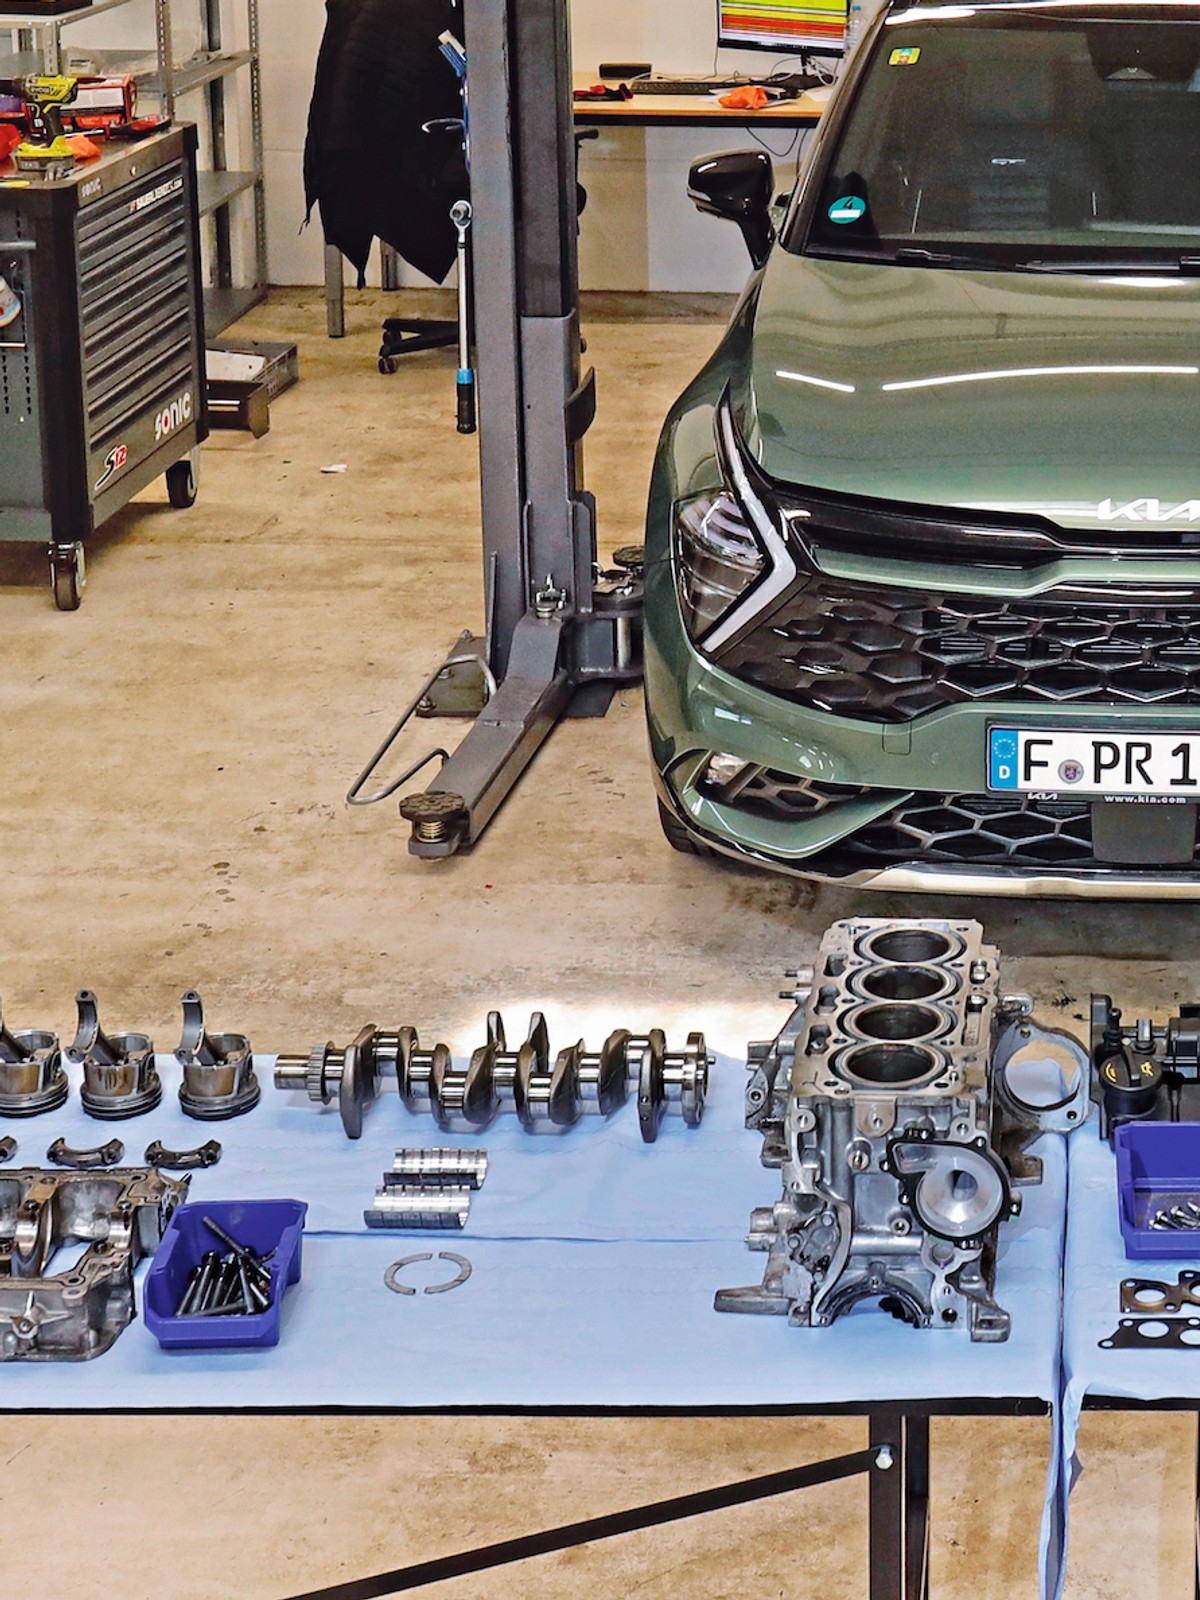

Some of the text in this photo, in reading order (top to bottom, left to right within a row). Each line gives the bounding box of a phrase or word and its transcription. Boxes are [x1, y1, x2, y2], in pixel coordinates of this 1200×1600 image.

[843, 197, 854, 210] 4
[999, 765, 1011, 779] D
[1023, 739, 1054, 782] F
[1091, 741, 1154, 785] PR
[1104, 793, 1187, 805] www.kia.com
